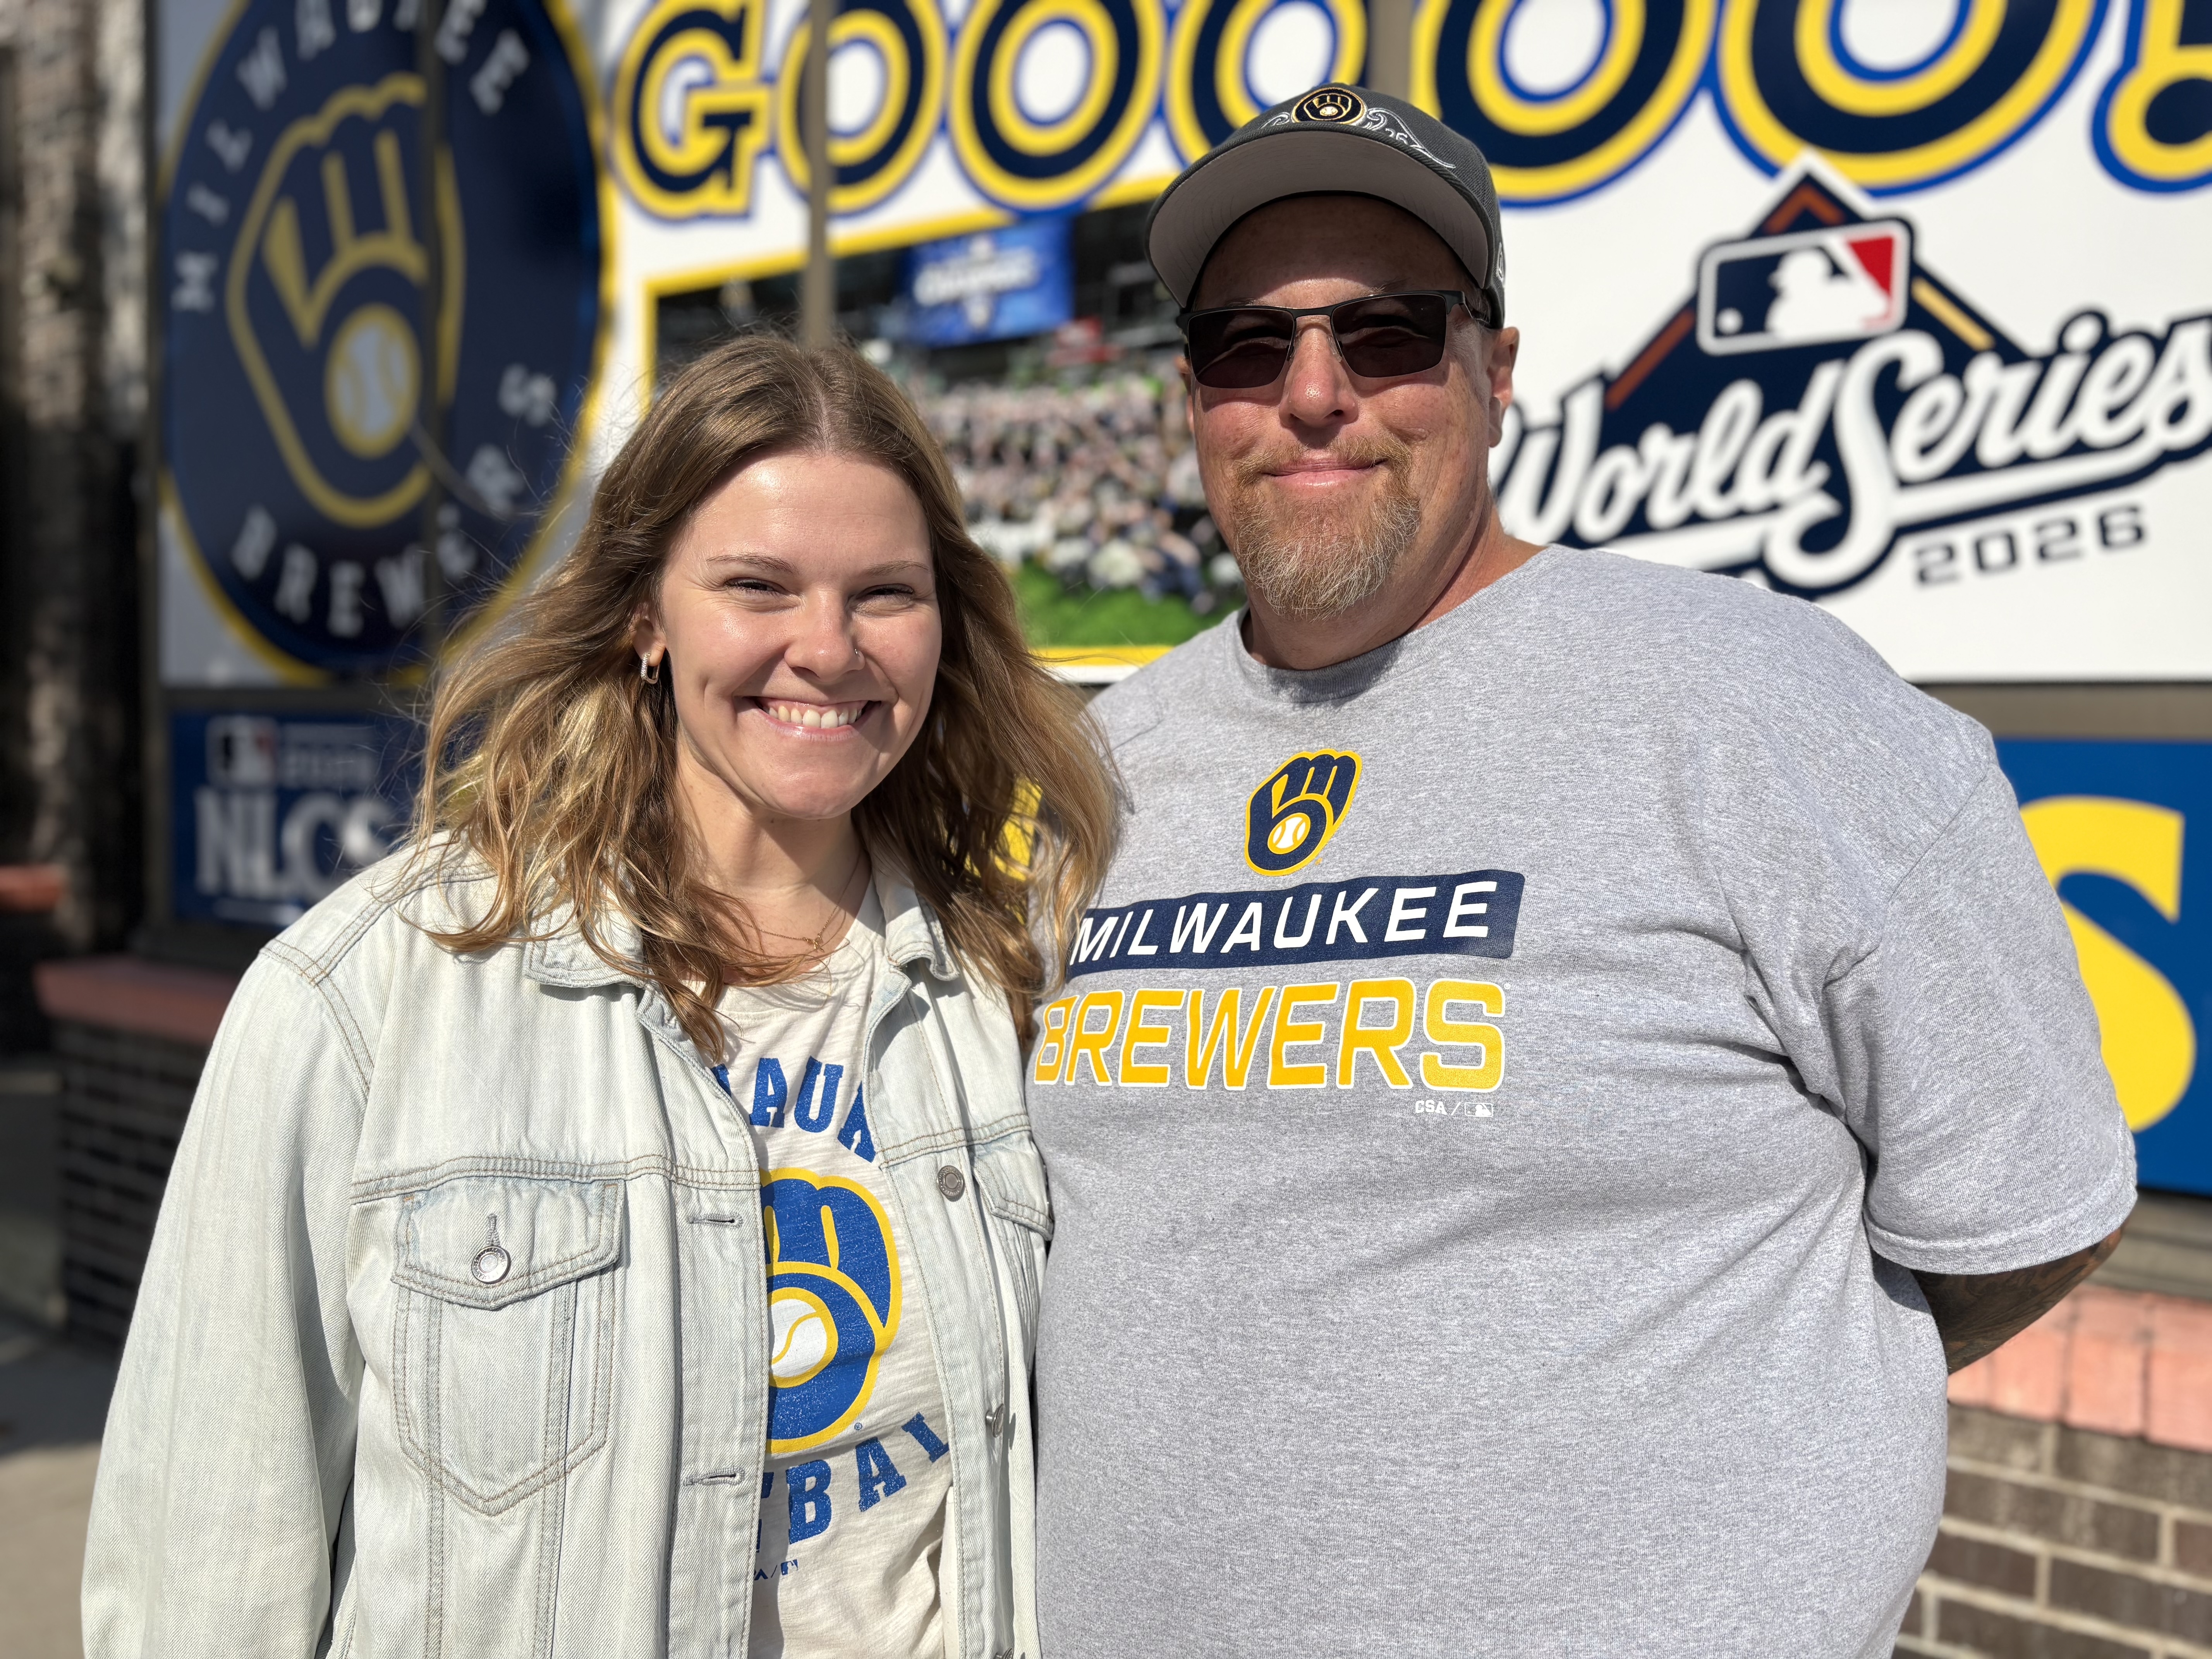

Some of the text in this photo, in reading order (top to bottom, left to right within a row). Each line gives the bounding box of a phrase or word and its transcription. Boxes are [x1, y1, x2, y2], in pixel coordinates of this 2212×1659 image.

[1488, 312, 2212, 588] World Series
[1912, 507, 2146, 584] 2026
[1070, 881, 1498, 966] MILWAUKEE
[1034, 977, 1506, 1092] BREWERS
